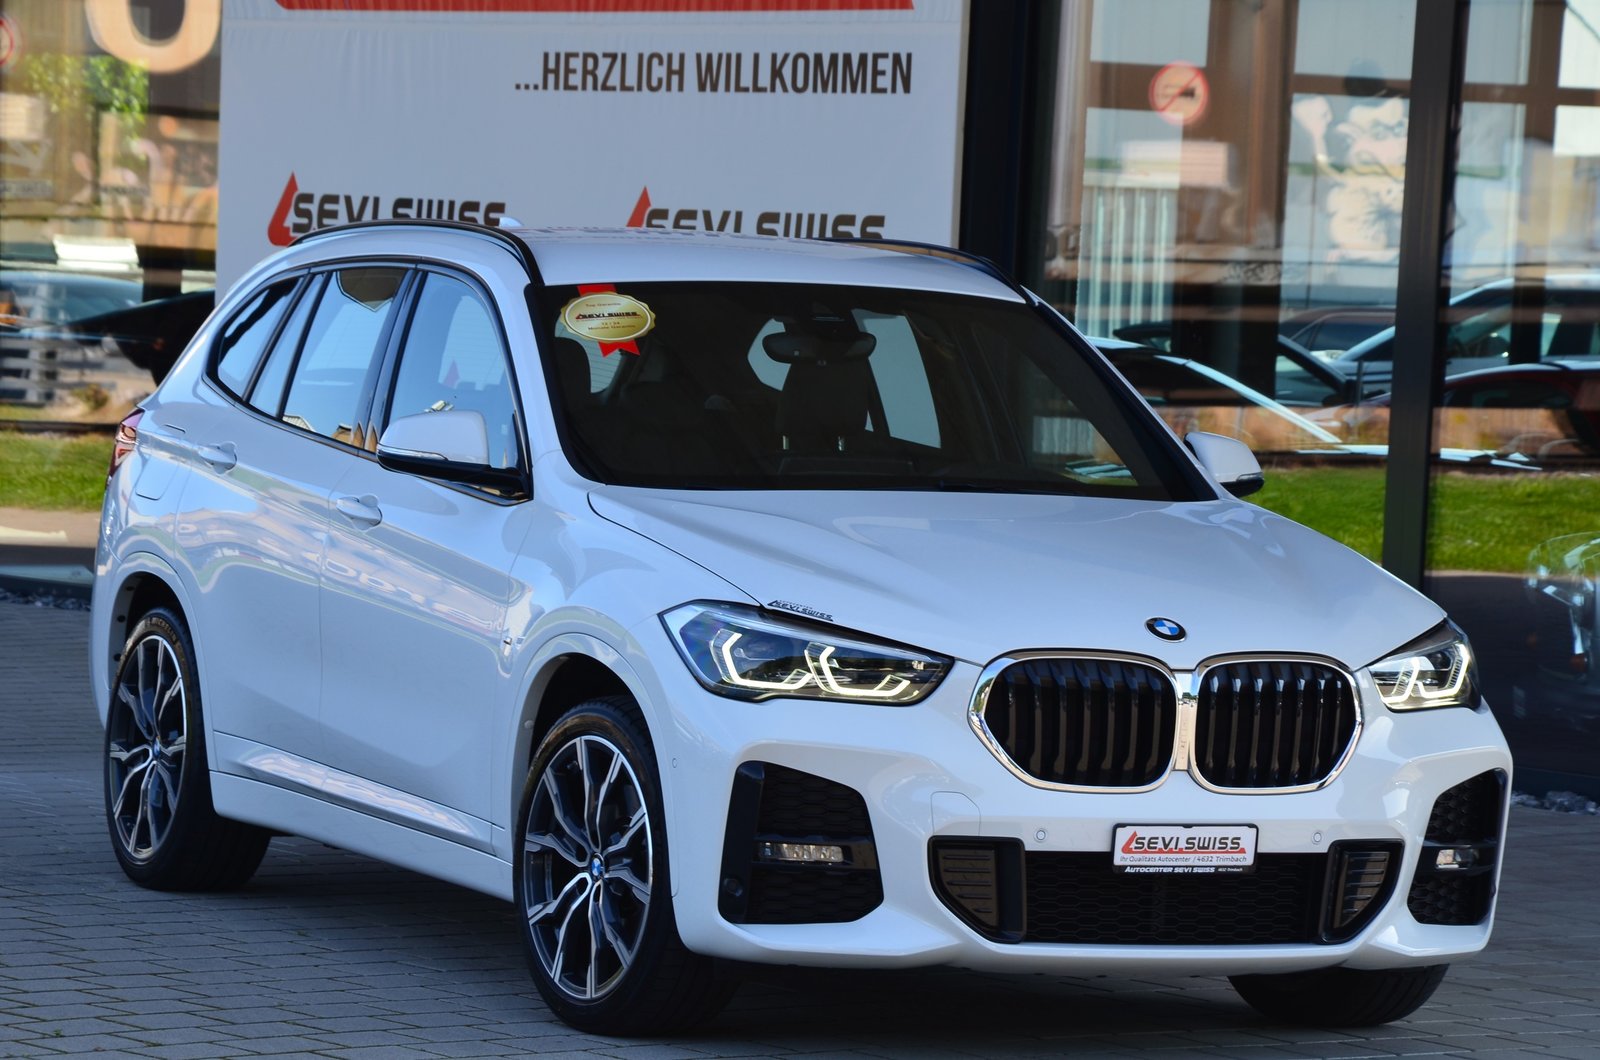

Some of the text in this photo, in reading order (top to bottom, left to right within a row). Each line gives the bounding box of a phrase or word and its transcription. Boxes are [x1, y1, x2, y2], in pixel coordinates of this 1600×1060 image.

[514, 51, 913, 94] ...HERZLICH WILLKOMMEN
[292, 192, 380, 234] SEVI
[801, 608, 833, 619] SWISS
[1133, 836, 1241, 850] SEVI SWISS
